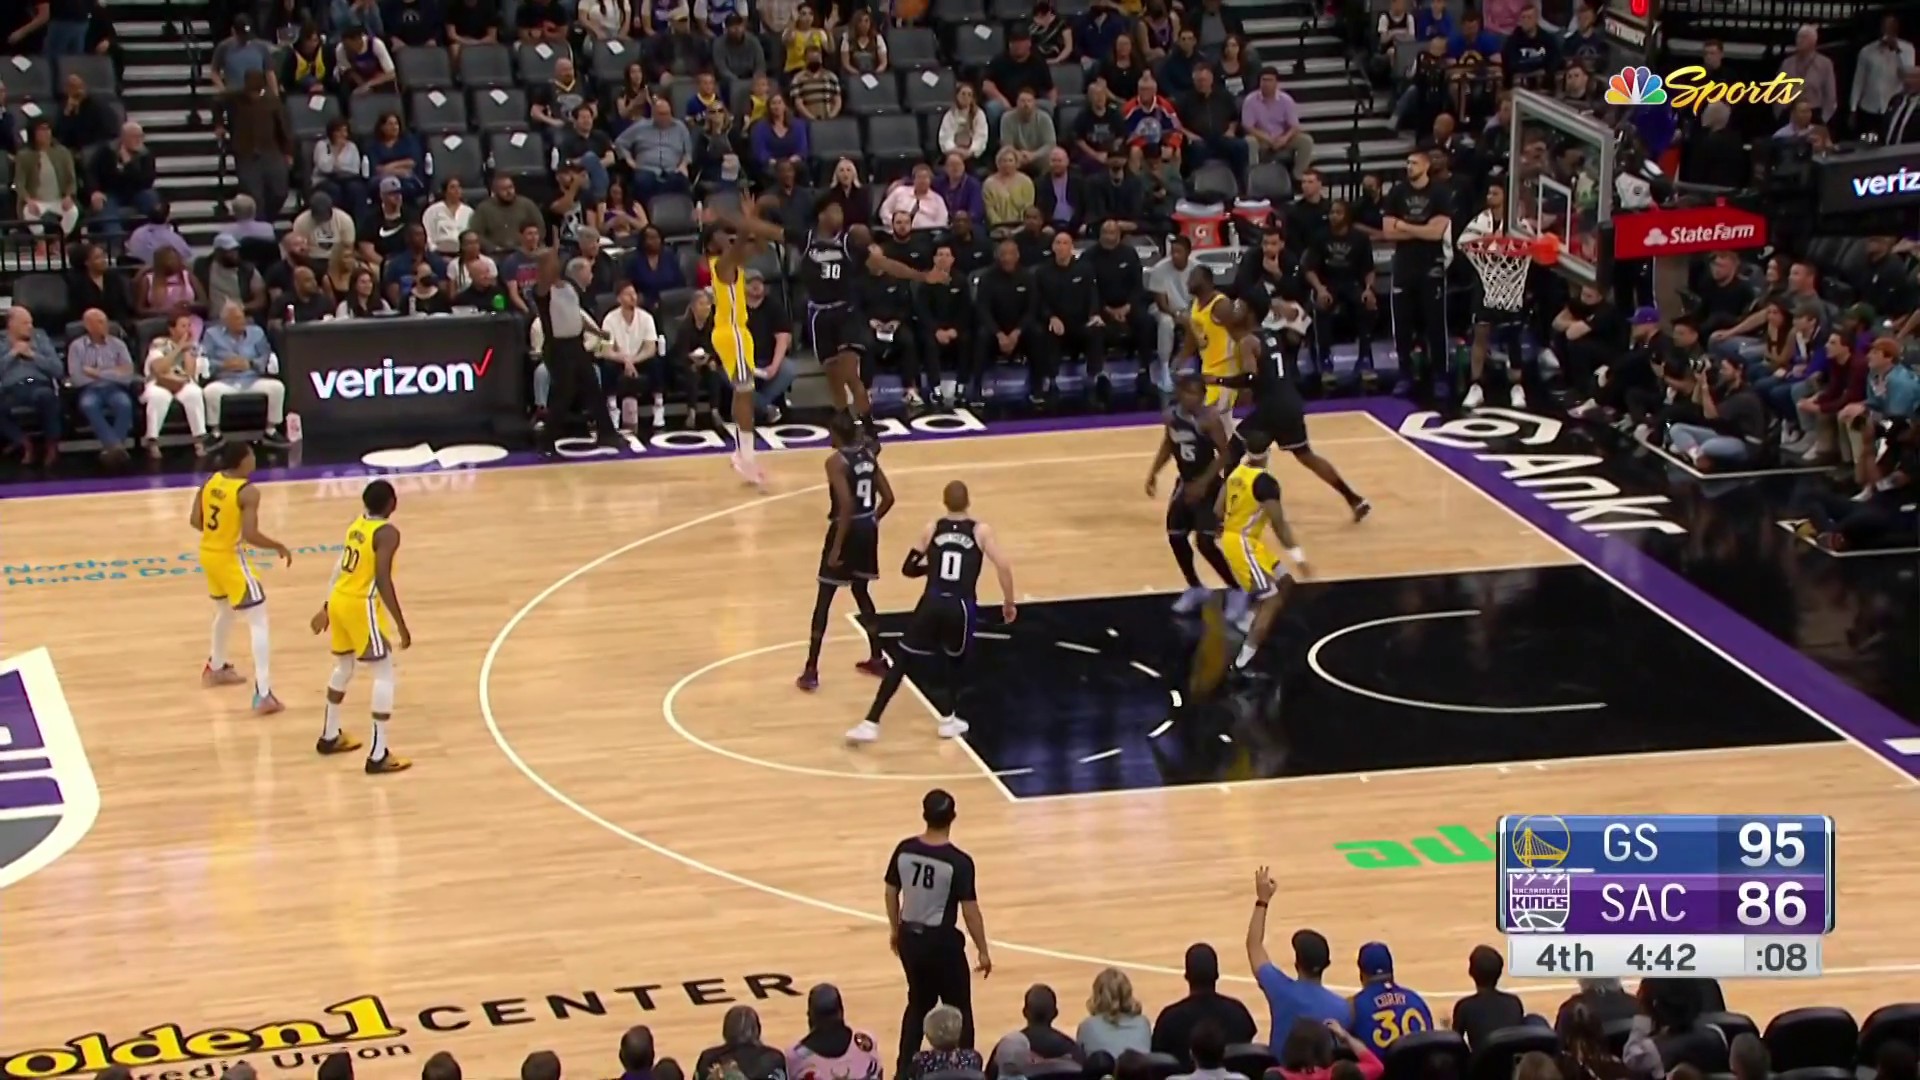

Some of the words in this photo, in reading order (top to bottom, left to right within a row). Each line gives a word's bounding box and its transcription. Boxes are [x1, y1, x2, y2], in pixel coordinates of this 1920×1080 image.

[310, 358, 475, 399] verizon
[1270, 352, 1285, 379] 7
[856, 478, 872, 507] 9
[206, 503, 221, 531] 3
[940, 550, 962, 581] 0
[910, 860, 936, 889] 78
[417, 972, 804, 1032] CENTER
[1371, 1007, 1428, 1049] 30
